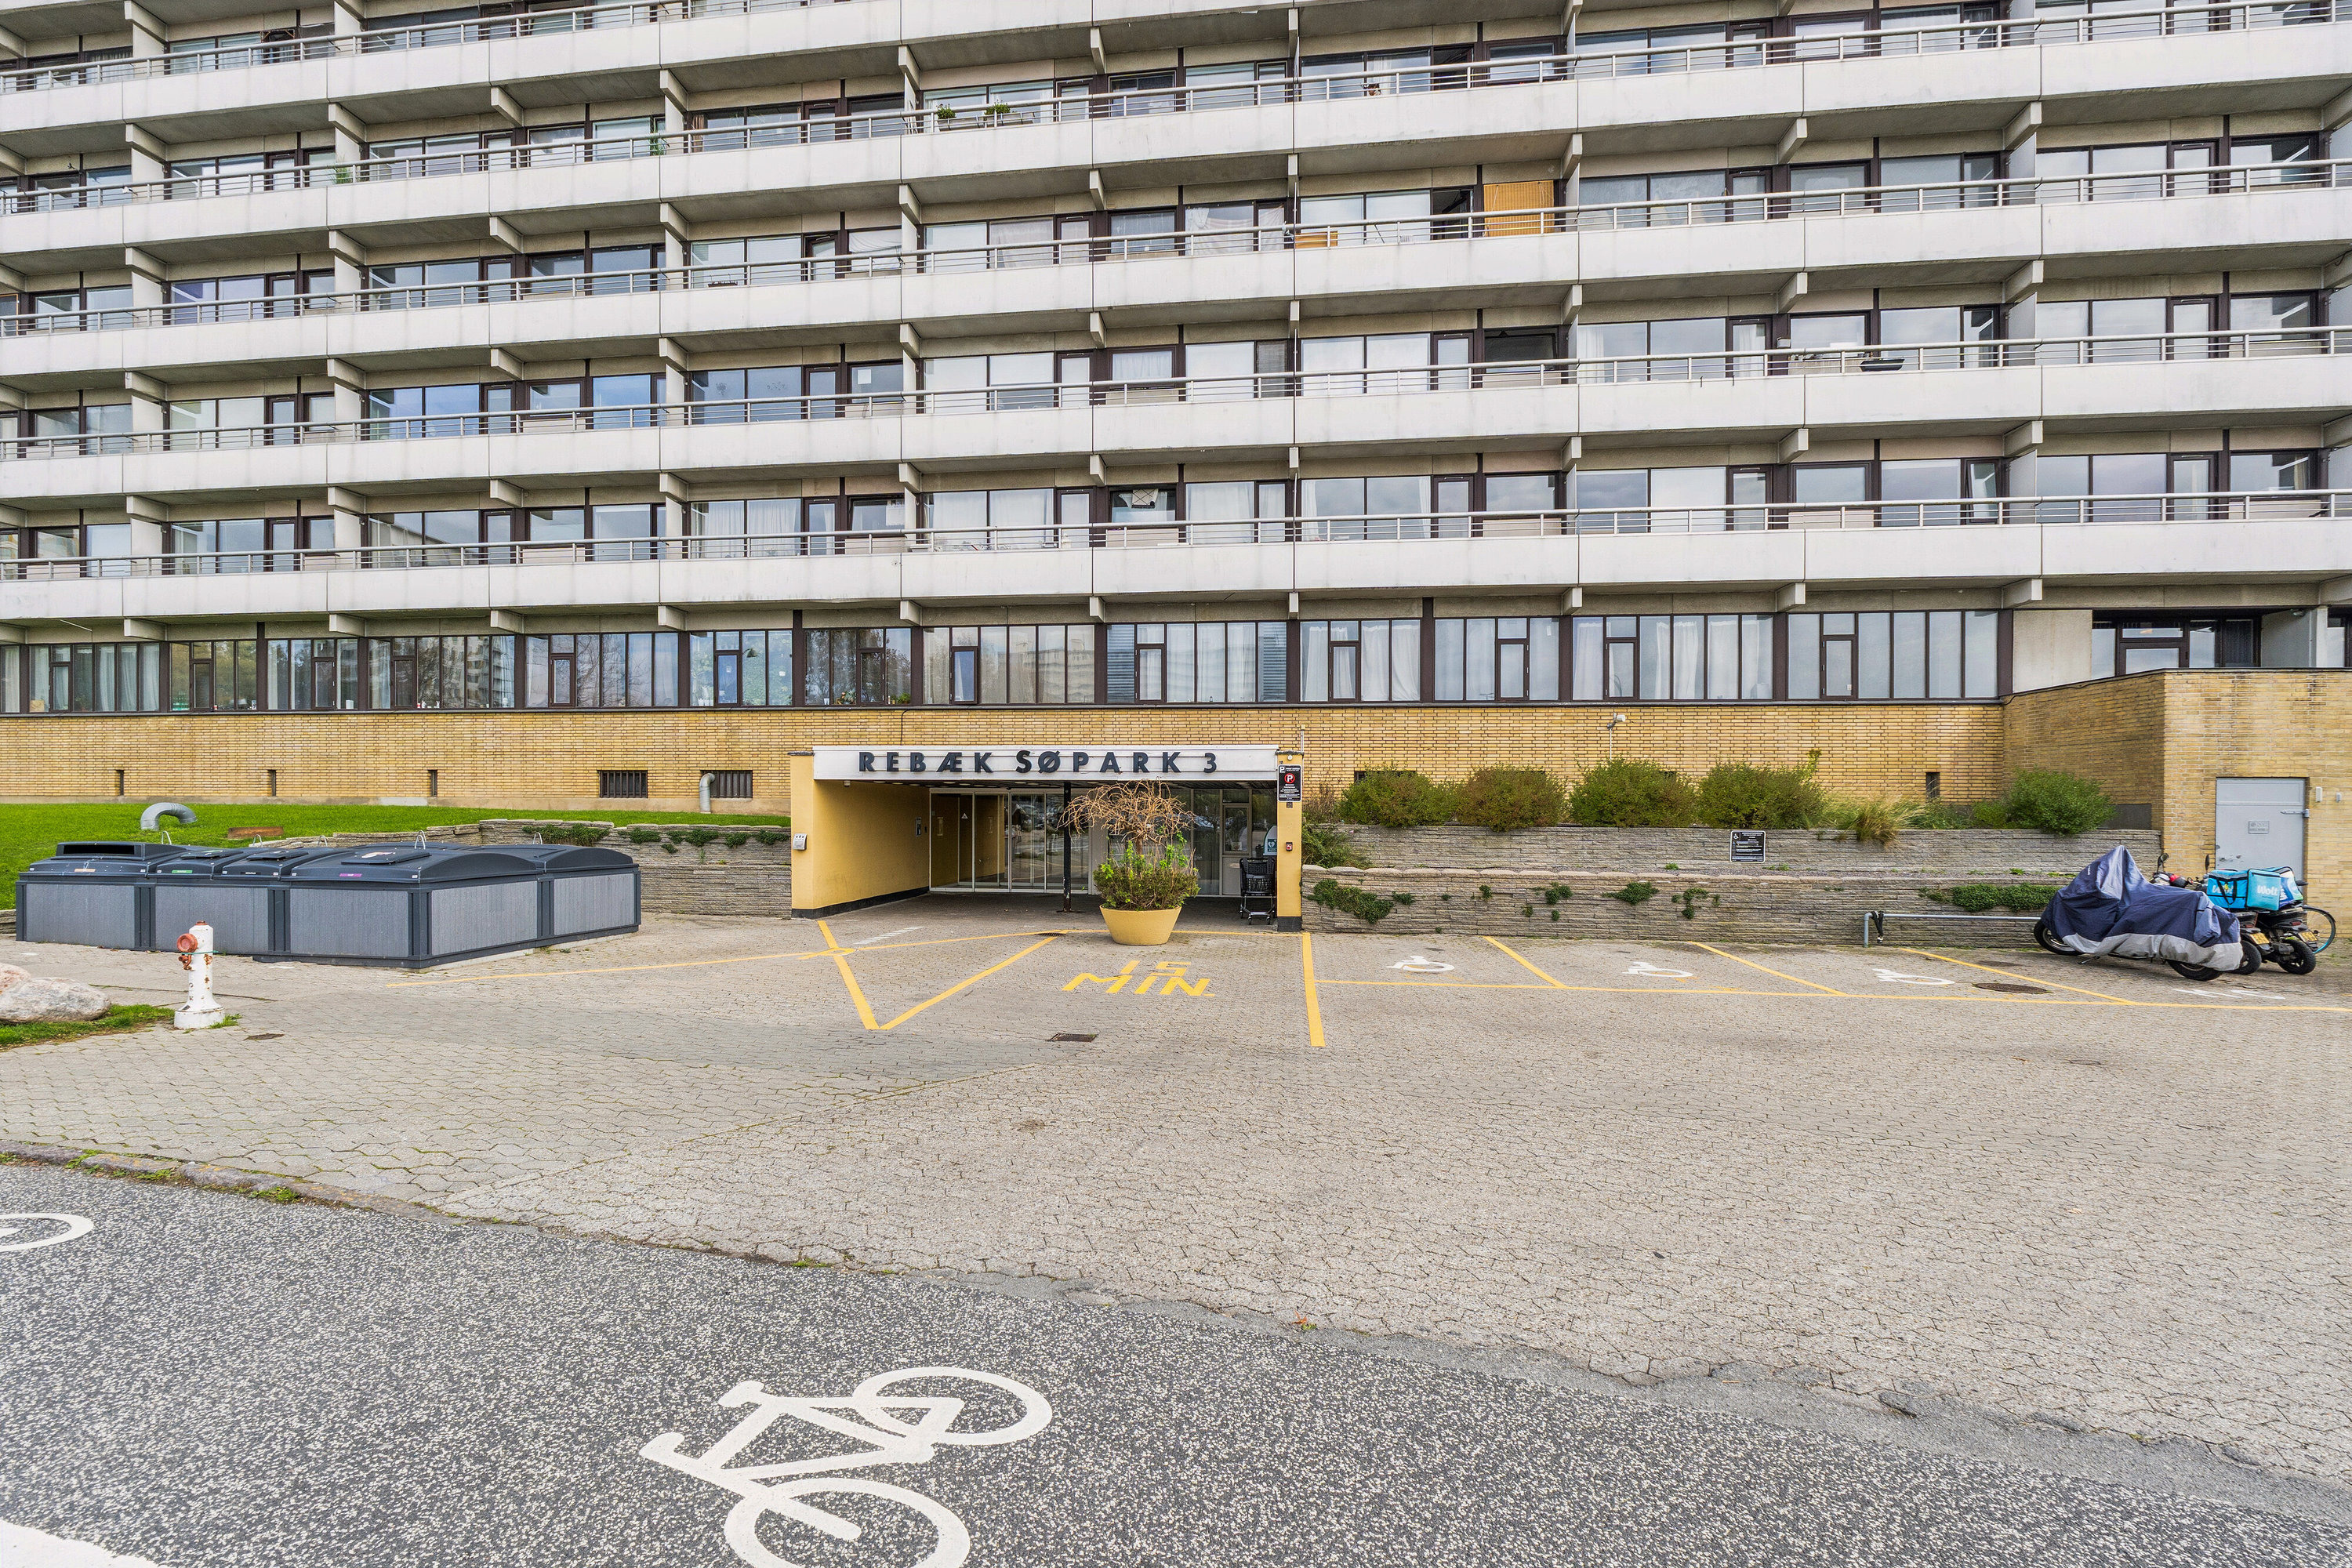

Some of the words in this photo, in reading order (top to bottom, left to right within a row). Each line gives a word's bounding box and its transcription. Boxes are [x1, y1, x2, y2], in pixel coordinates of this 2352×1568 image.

[858, 751, 994, 773] REBÆK
[1016, 750, 1181, 774] SØPARK
[1203, 752, 1218, 774] 3
[2258, 885, 2278, 895] Wolt
[1121, 960, 1192, 977] 15
